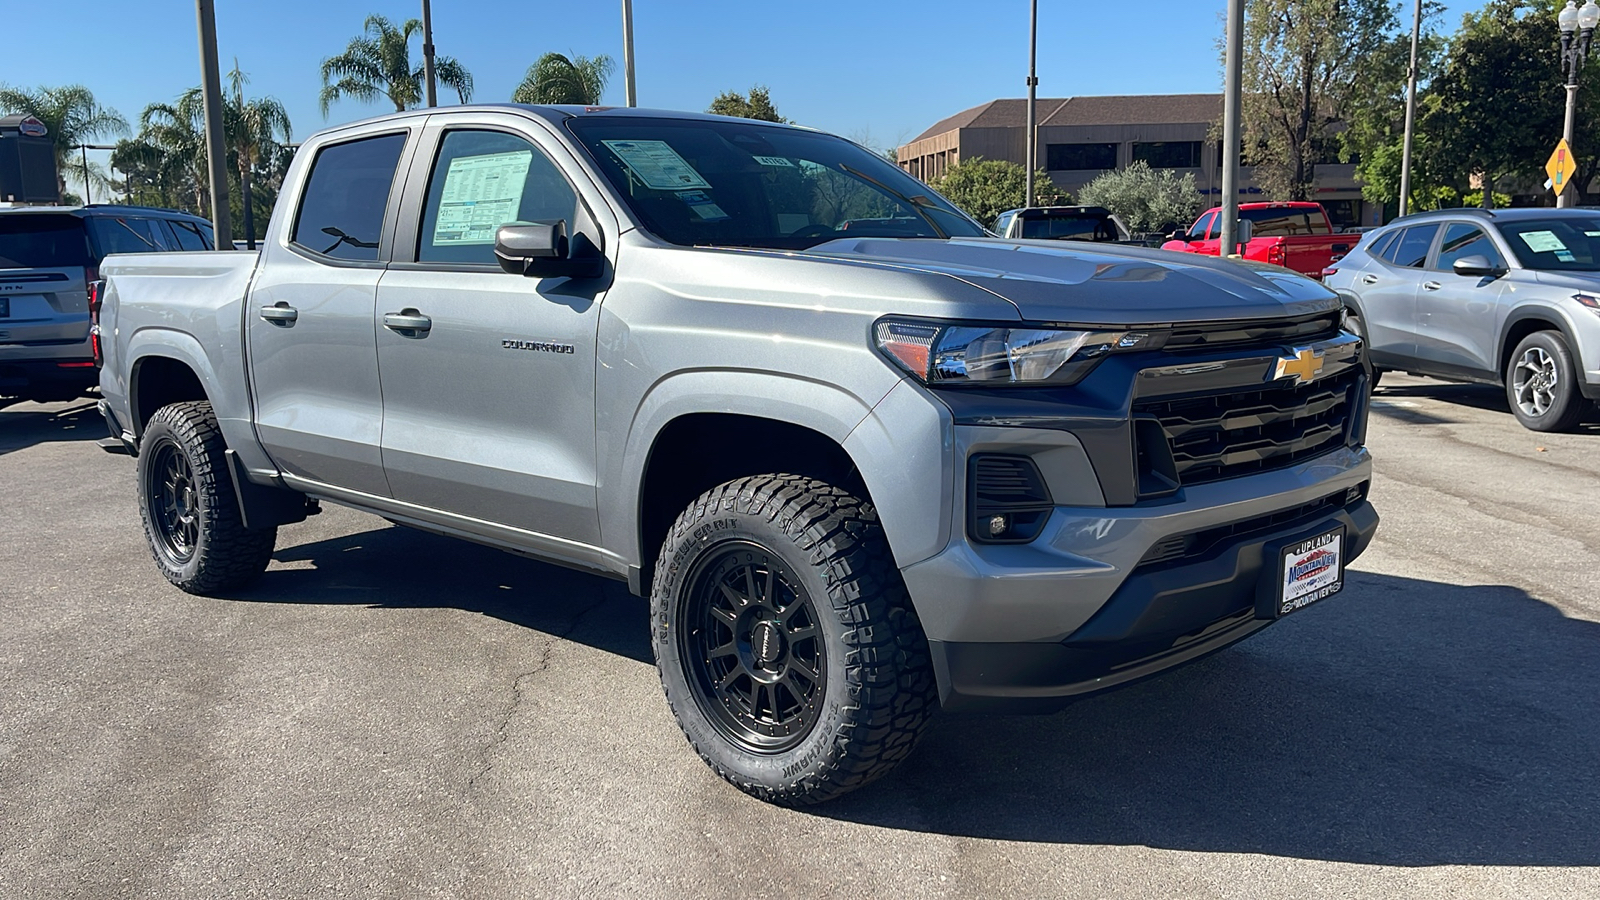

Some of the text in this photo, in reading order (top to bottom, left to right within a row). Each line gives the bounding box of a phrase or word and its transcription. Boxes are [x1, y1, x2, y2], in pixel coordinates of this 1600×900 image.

[502, 339, 574, 354] COLORADO
[1302, 533, 1330, 553] UPLAND
[659, 518, 738, 645] RIDGECRAWLER R/T
[1288, 553, 1337, 586] MOUNTAIN VIEW
